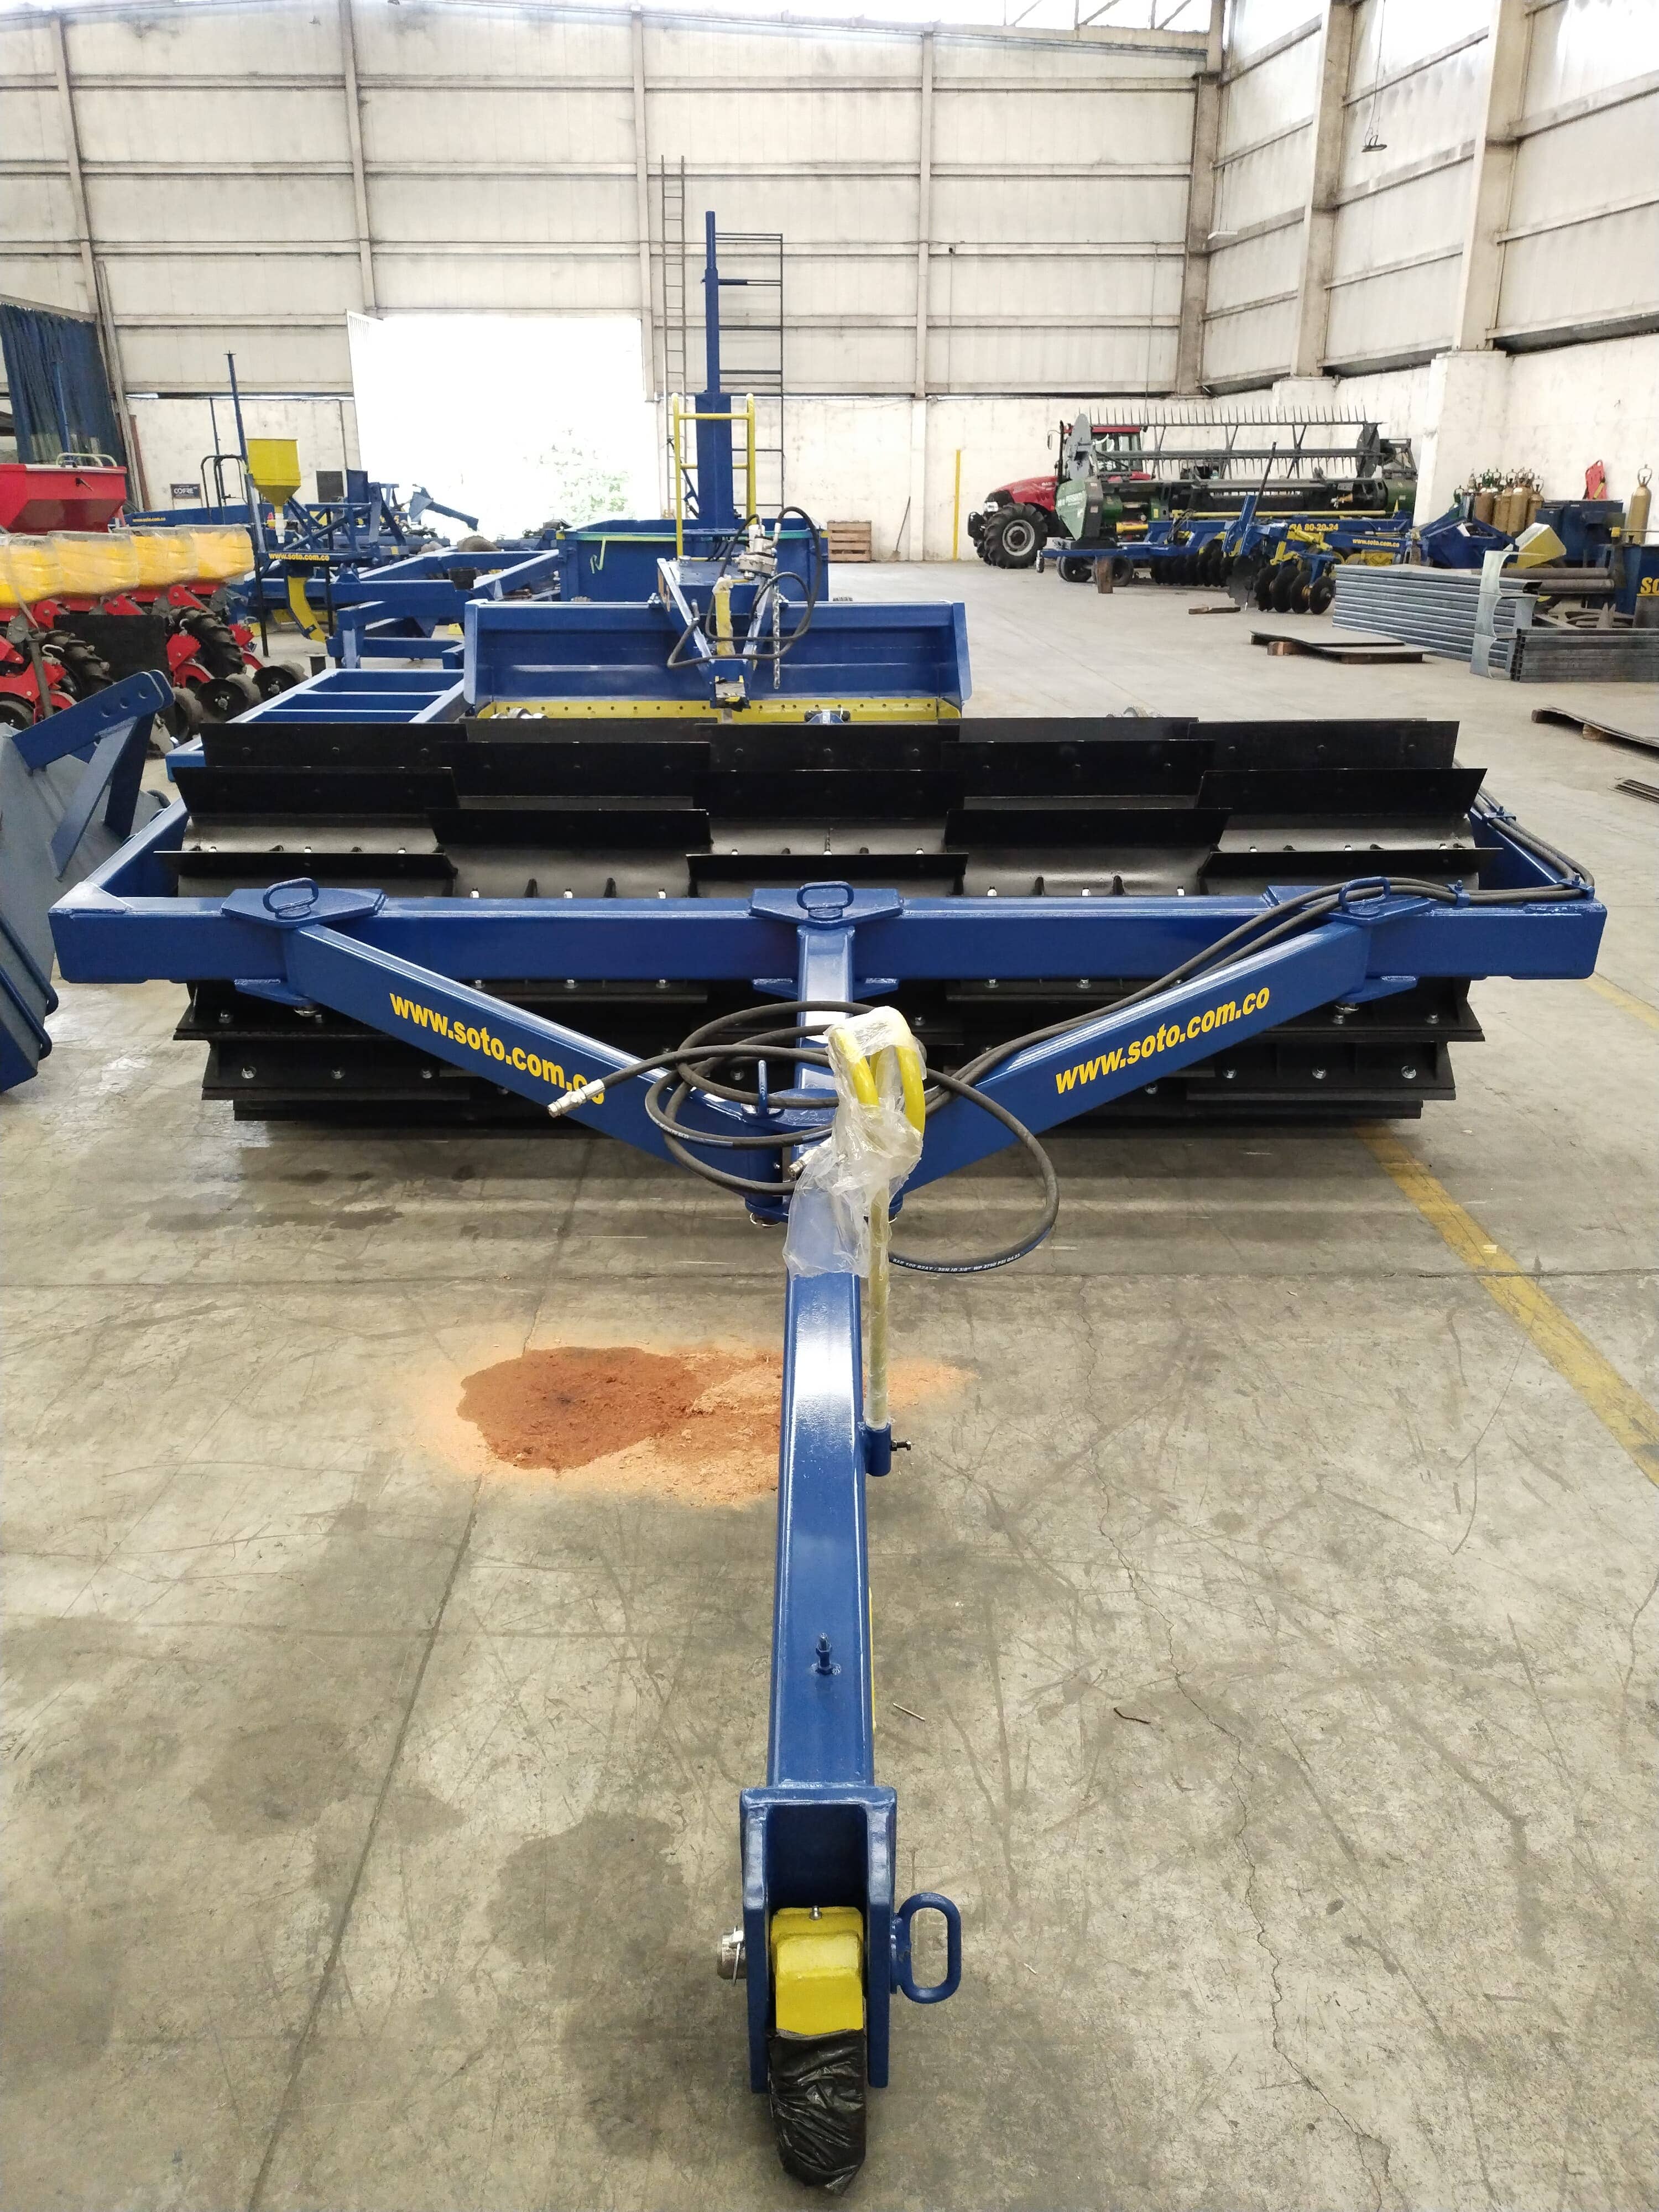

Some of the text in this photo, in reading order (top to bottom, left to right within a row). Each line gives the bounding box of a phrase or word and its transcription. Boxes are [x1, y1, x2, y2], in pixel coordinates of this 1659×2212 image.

[1352, 539, 1400, 547] www.soto.com.co
[268, 553, 330, 561] www.soto.com.co
[1055, 987, 1270, 1094] www.soto.com.co
